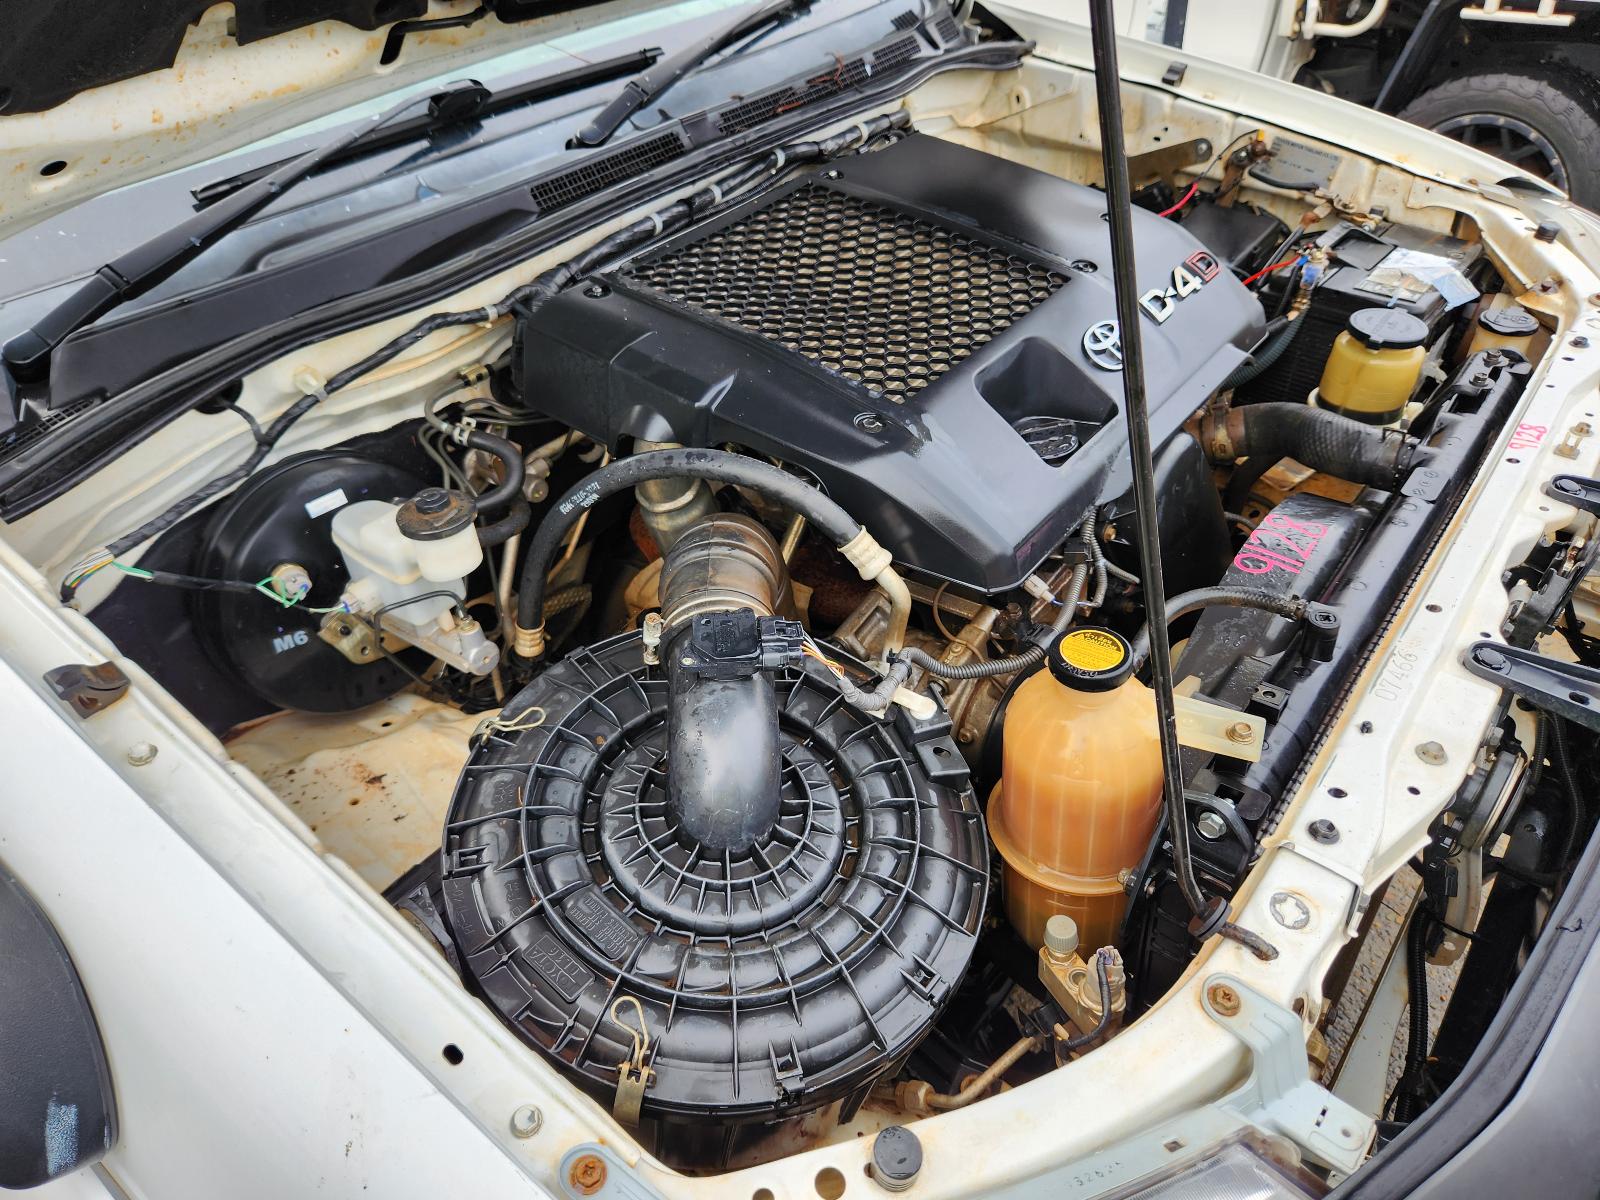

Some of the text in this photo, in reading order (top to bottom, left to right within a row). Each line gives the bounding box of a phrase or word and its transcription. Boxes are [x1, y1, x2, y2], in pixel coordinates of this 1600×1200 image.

[1139, 251, 1219, 324] D-4D
[1510, 423, 1547, 449] 9128
[1234, 513, 1328, 574] 9128
[272, 630, 308, 653] M6
[1085, 637, 1118, 650] CAUTION
[529, 946, 575, 995] TOYOTA
